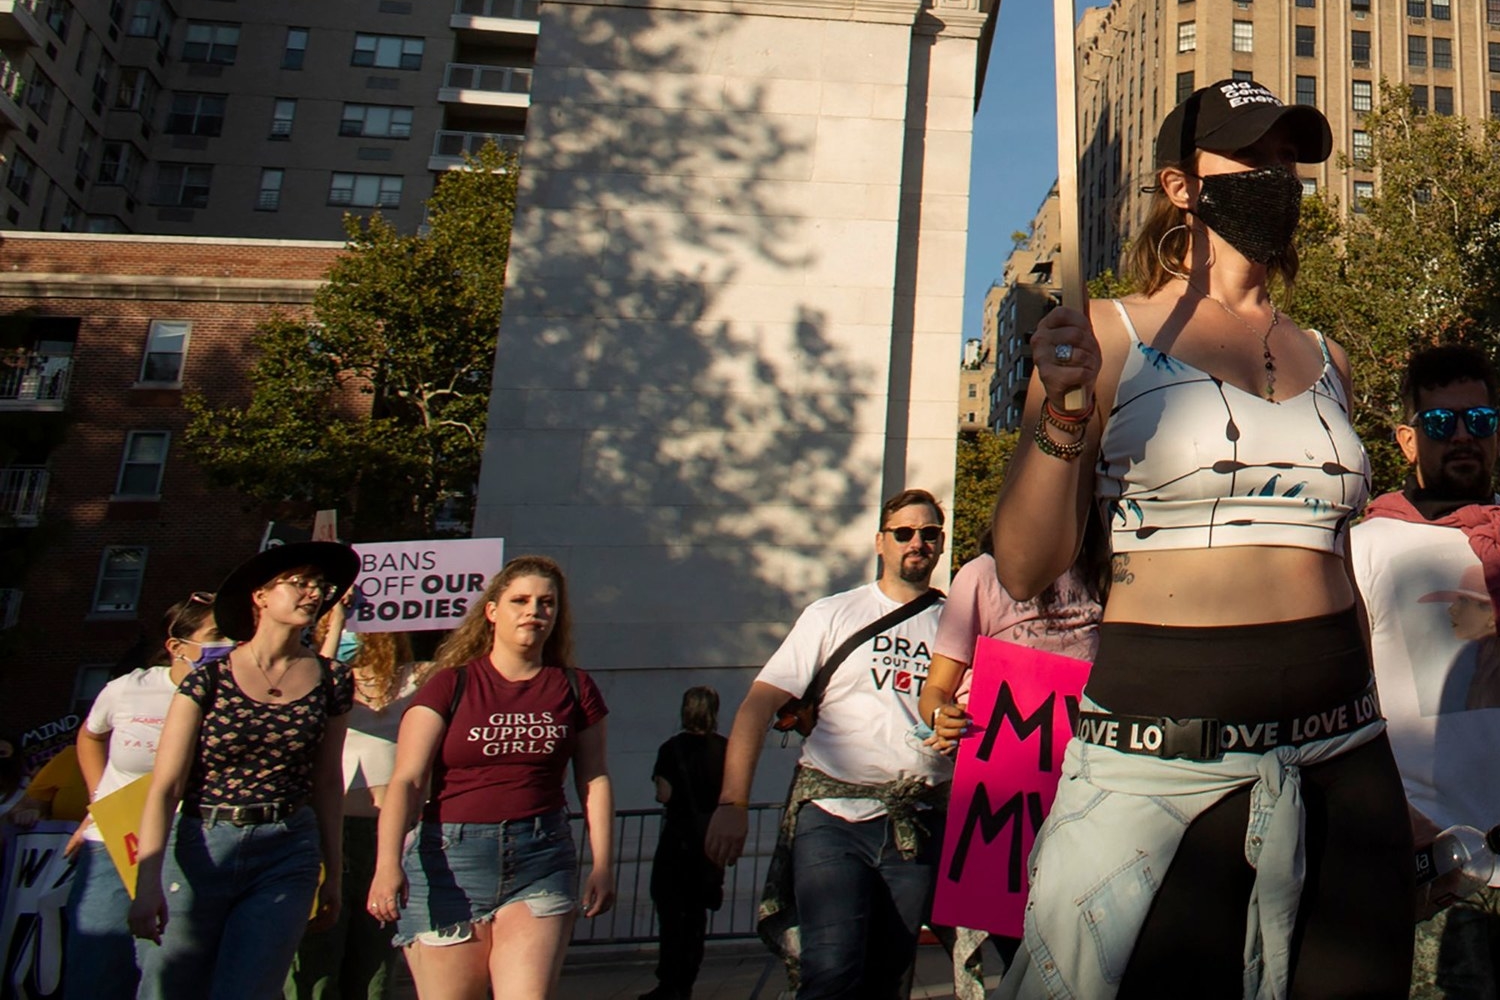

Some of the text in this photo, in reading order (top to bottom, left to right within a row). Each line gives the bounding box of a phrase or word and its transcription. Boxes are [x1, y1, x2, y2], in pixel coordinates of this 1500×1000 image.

[1229, 95, 1284, 108] Energ
[360, 551, 436, 573] BANS
[360, 573, 485, 598] OFF OUR
[357, 598, 468, 622] BODIES
[873, 636, 932, 660] DRA
[883, 656, 930, 673] OUT TH
[871, 667, 927, 697] VOT
[489, 711, 554, 726] GIRLS
[1220, 723, 1280, 749] OVE
[1291, 705, 1347, 742] LOVE
[1354, 689, 1381, 724] LOV
[22, 714, 81, 747] MIND
[467, 725, 569, 741] SUPPORT
[482, 740, 556, 756] GIRLS
